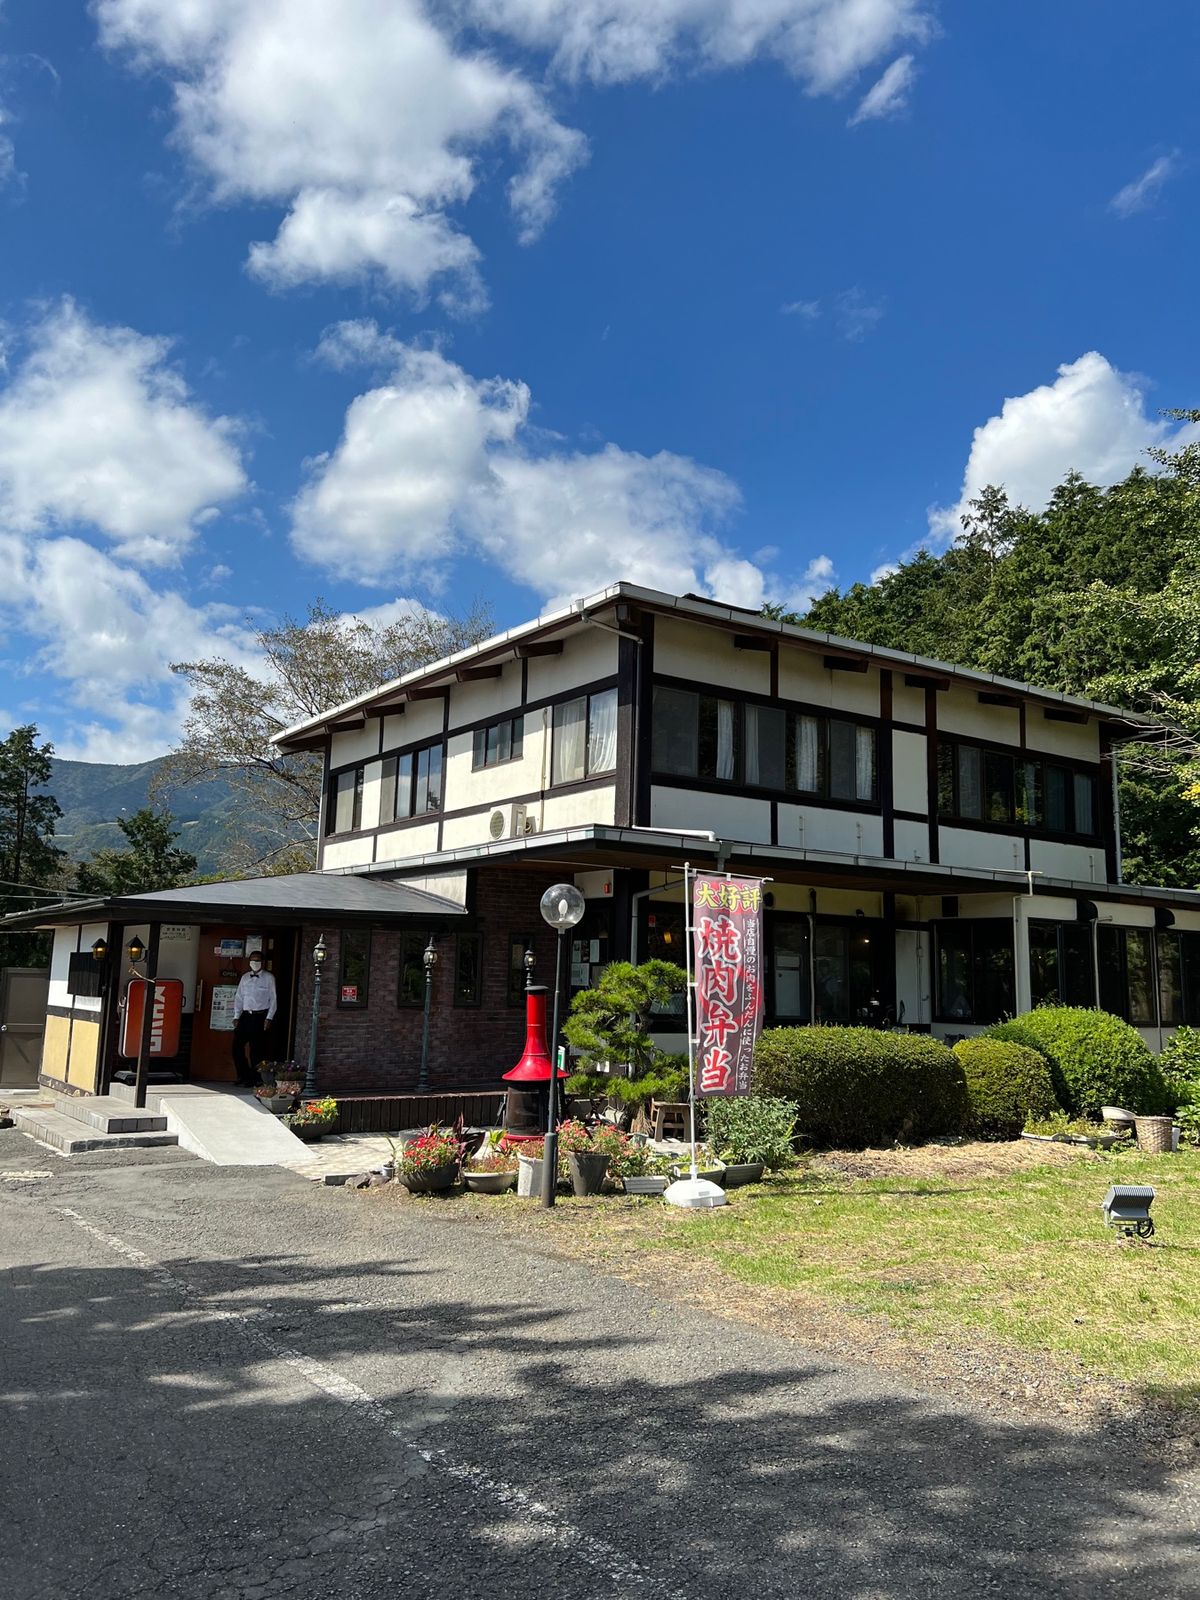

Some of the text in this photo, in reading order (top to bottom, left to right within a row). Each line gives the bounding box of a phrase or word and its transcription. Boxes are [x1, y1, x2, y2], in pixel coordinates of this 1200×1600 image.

[694, 880, 762, 913] 大好評
[698, 914, 742, 1093] 焼肉弁当
